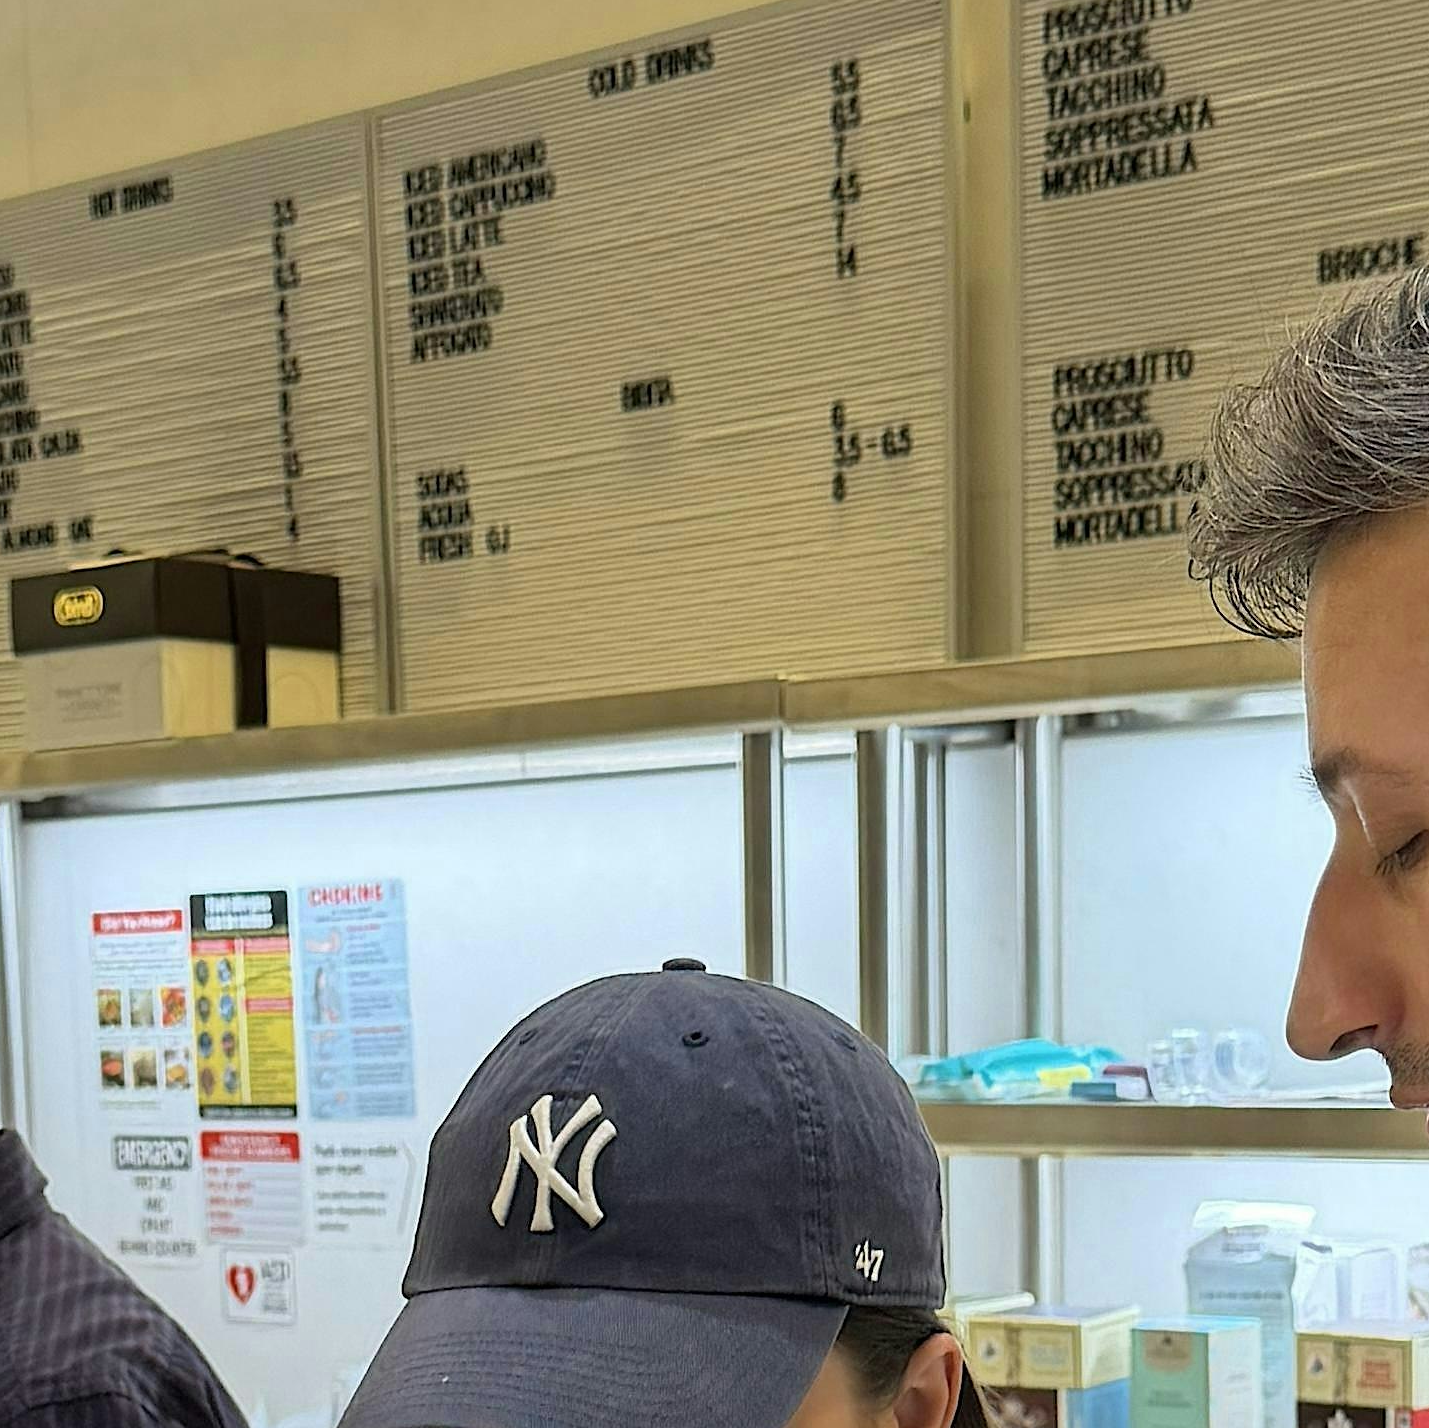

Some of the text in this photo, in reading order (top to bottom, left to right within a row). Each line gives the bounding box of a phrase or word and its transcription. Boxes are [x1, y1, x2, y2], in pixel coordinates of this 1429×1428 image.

[587, 38, 715, 99] COLD DRINKS
[1044, 27, 1149, 82] CAPRESE
[1046, 64, 1165, 119] TACCHINO
[1045, 94, 1213, 160] SOPPRESSATA
[403, 139, 547, 199] ICED AMERICANO
[1042, 139, 1197, 200] MORTADELLA
[406, 197, 444, 230] ICED
[408, 216, 502, 262] ICED LATTE
[1317, 232, 1423, 284] BRIOCHE
[1054, 349, 1193, 398] PROSCIUTTO
[1053, 389, 1150, 436] CAPRESE
[1056, 428, 1164, 472] TACCHINO
[491, 1092, 619, 1231] NY
